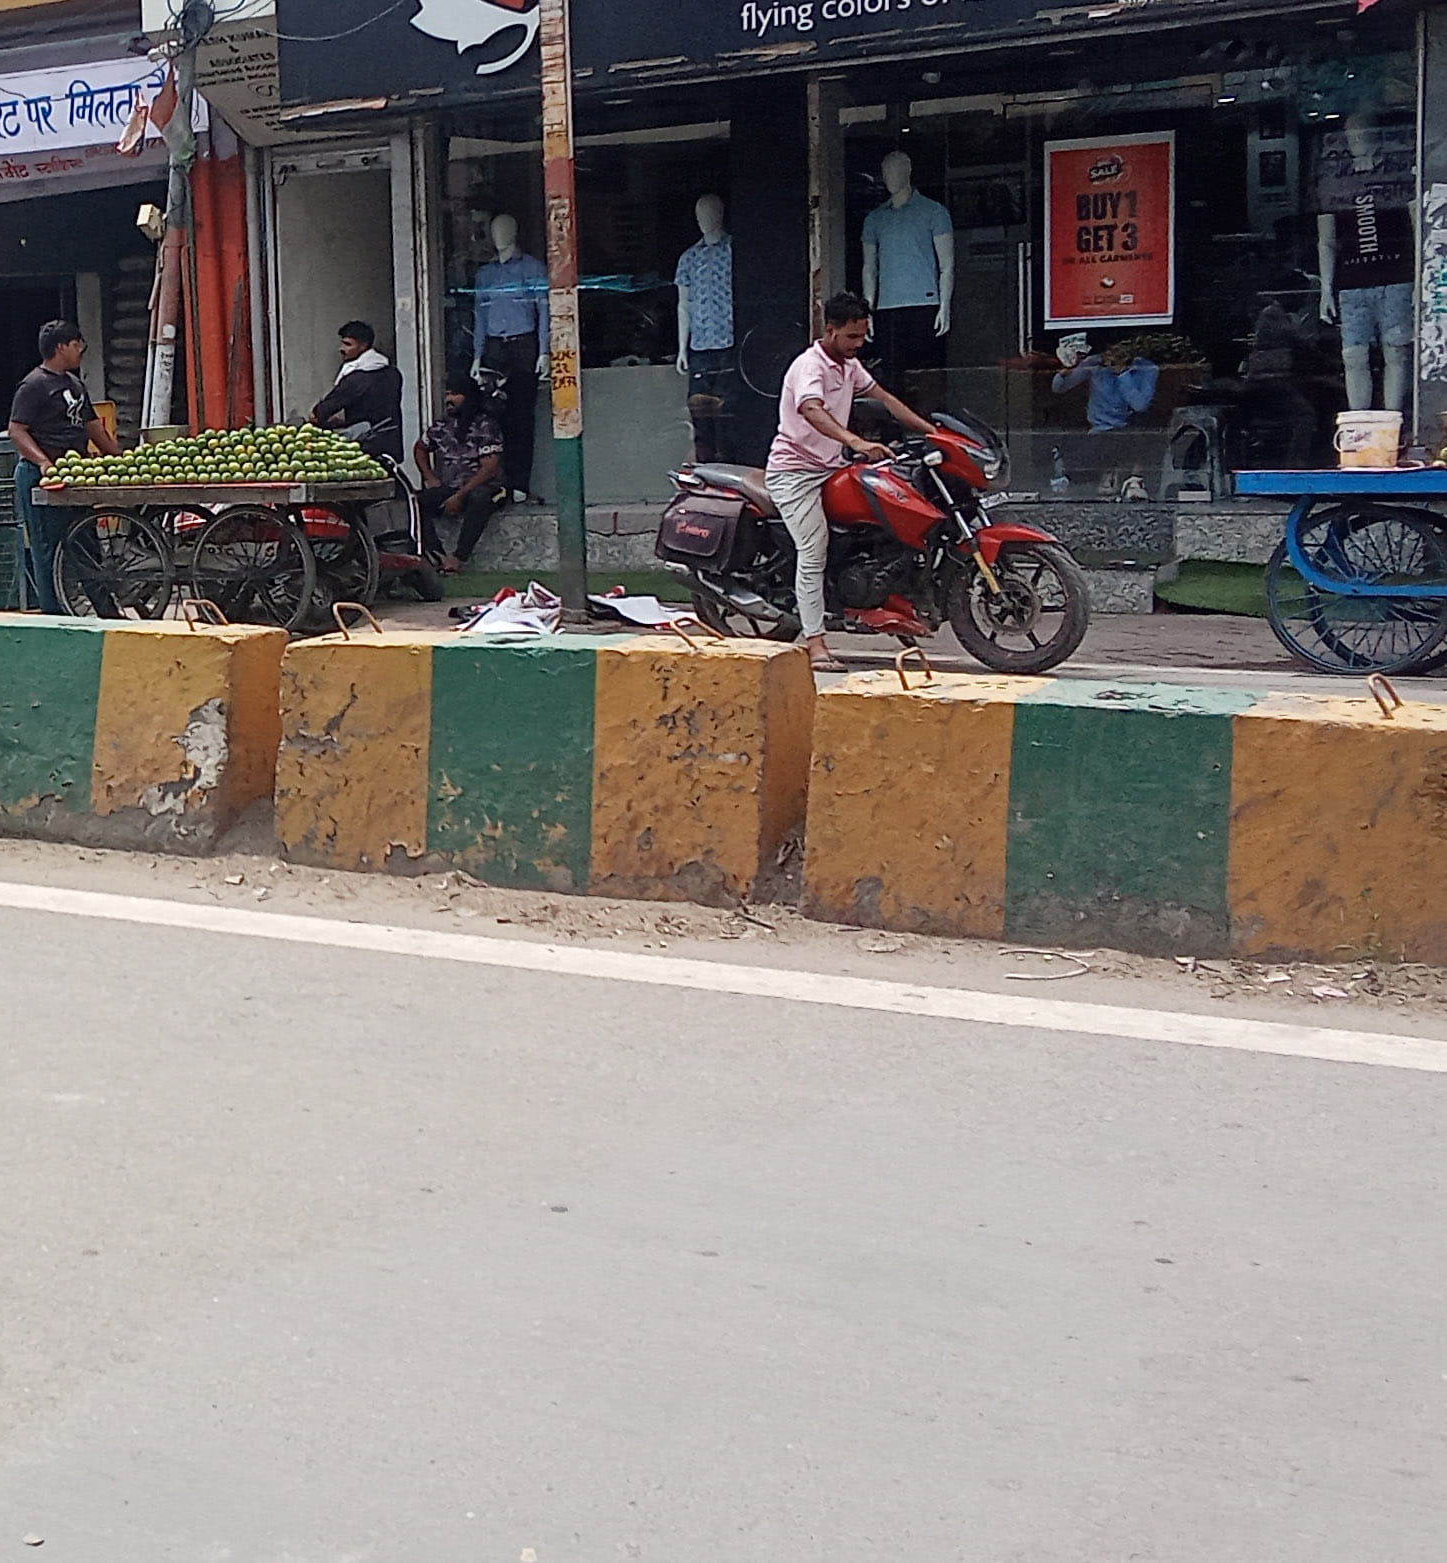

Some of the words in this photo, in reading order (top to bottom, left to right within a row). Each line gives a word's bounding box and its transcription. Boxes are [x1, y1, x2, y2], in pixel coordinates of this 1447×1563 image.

[741, 1, 814, 37] flying
[822, 0, 910, 19] colors
[24, 95, 59, 133] पर
[1089, 163, 1119, 180] SALE
[1076, 191, 1122, 221] BUY
[1124, 190, 1138, 219] 1
[1076, 224, 1118, 253] GET
[1120, 222, 1138, 251] 3
[1355, 194, 1379, 254] SMOOTH
